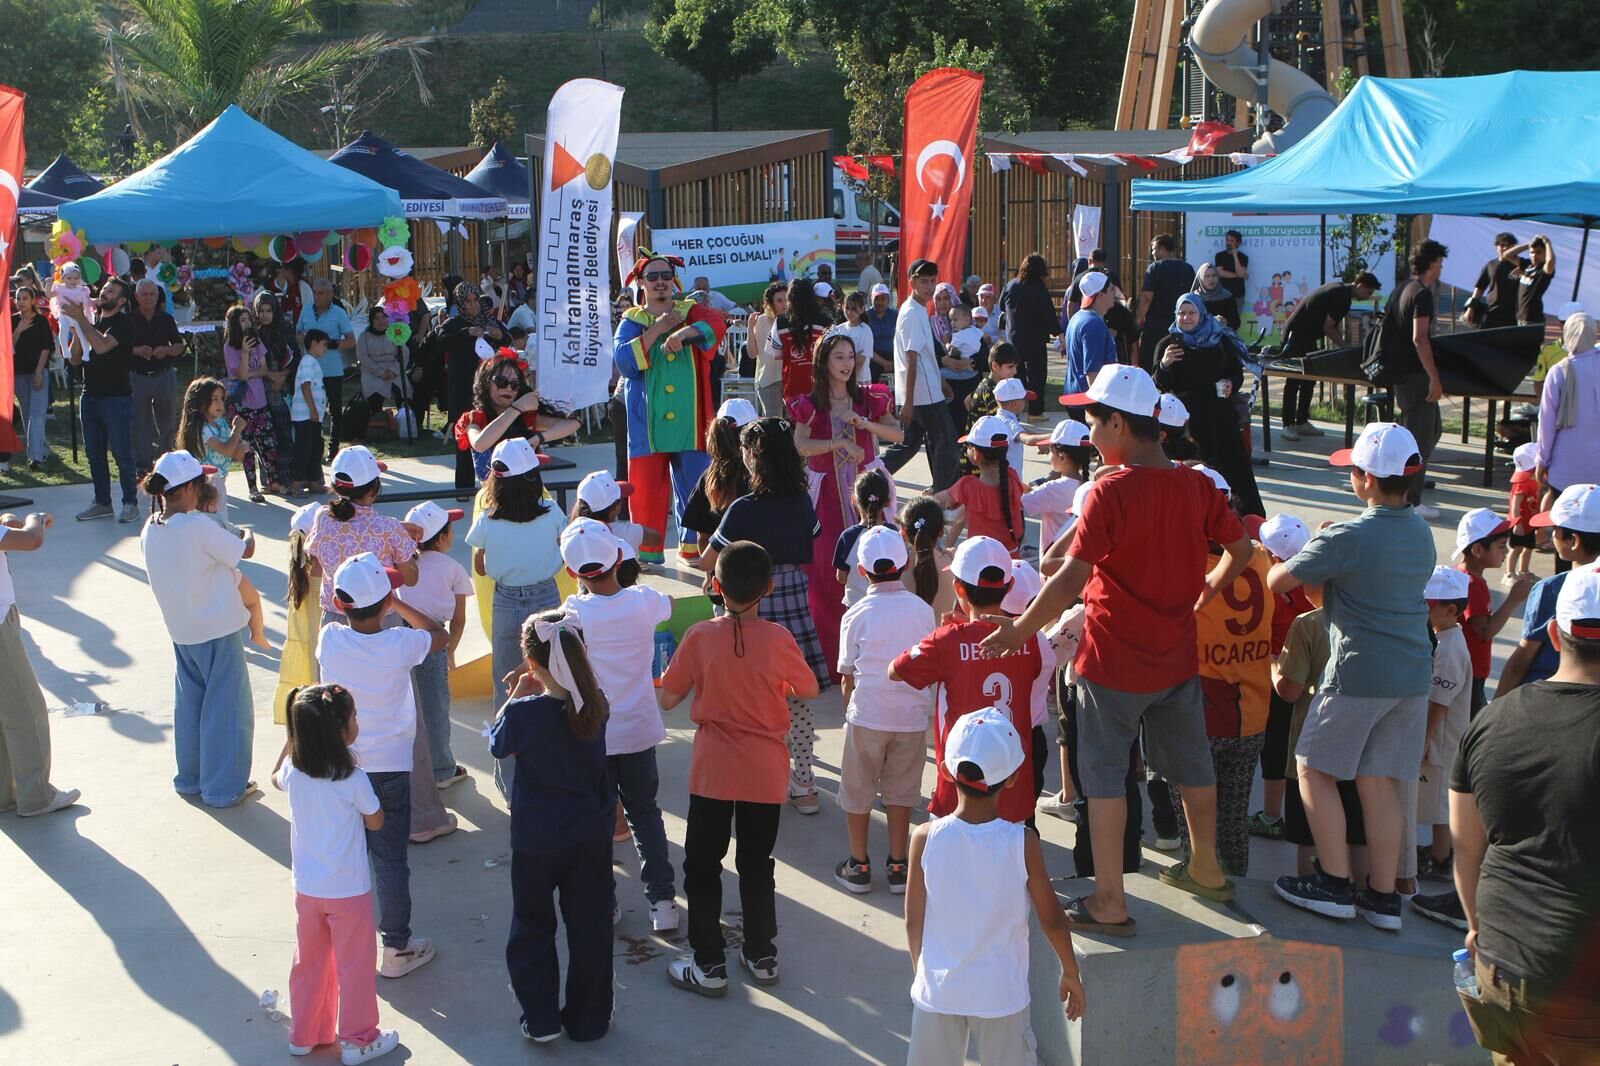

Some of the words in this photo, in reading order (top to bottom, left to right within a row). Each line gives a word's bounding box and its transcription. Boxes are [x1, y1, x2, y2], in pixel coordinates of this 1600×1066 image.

[583, 199, 600, 278] Belediyesi
[688, 254, 727, 266] AİLESİ
[706, 233, 764, 249] ÇOCUĞUN
[1207, 226, 1220, 236] 30
[1263, 226, 1312, 236] Koruyucu
[561, 198, 584, 365] Kahramanmaraş
[583, 281, 602, 367] Büyükşehir
[1221, 566, 1265, 636] 9
